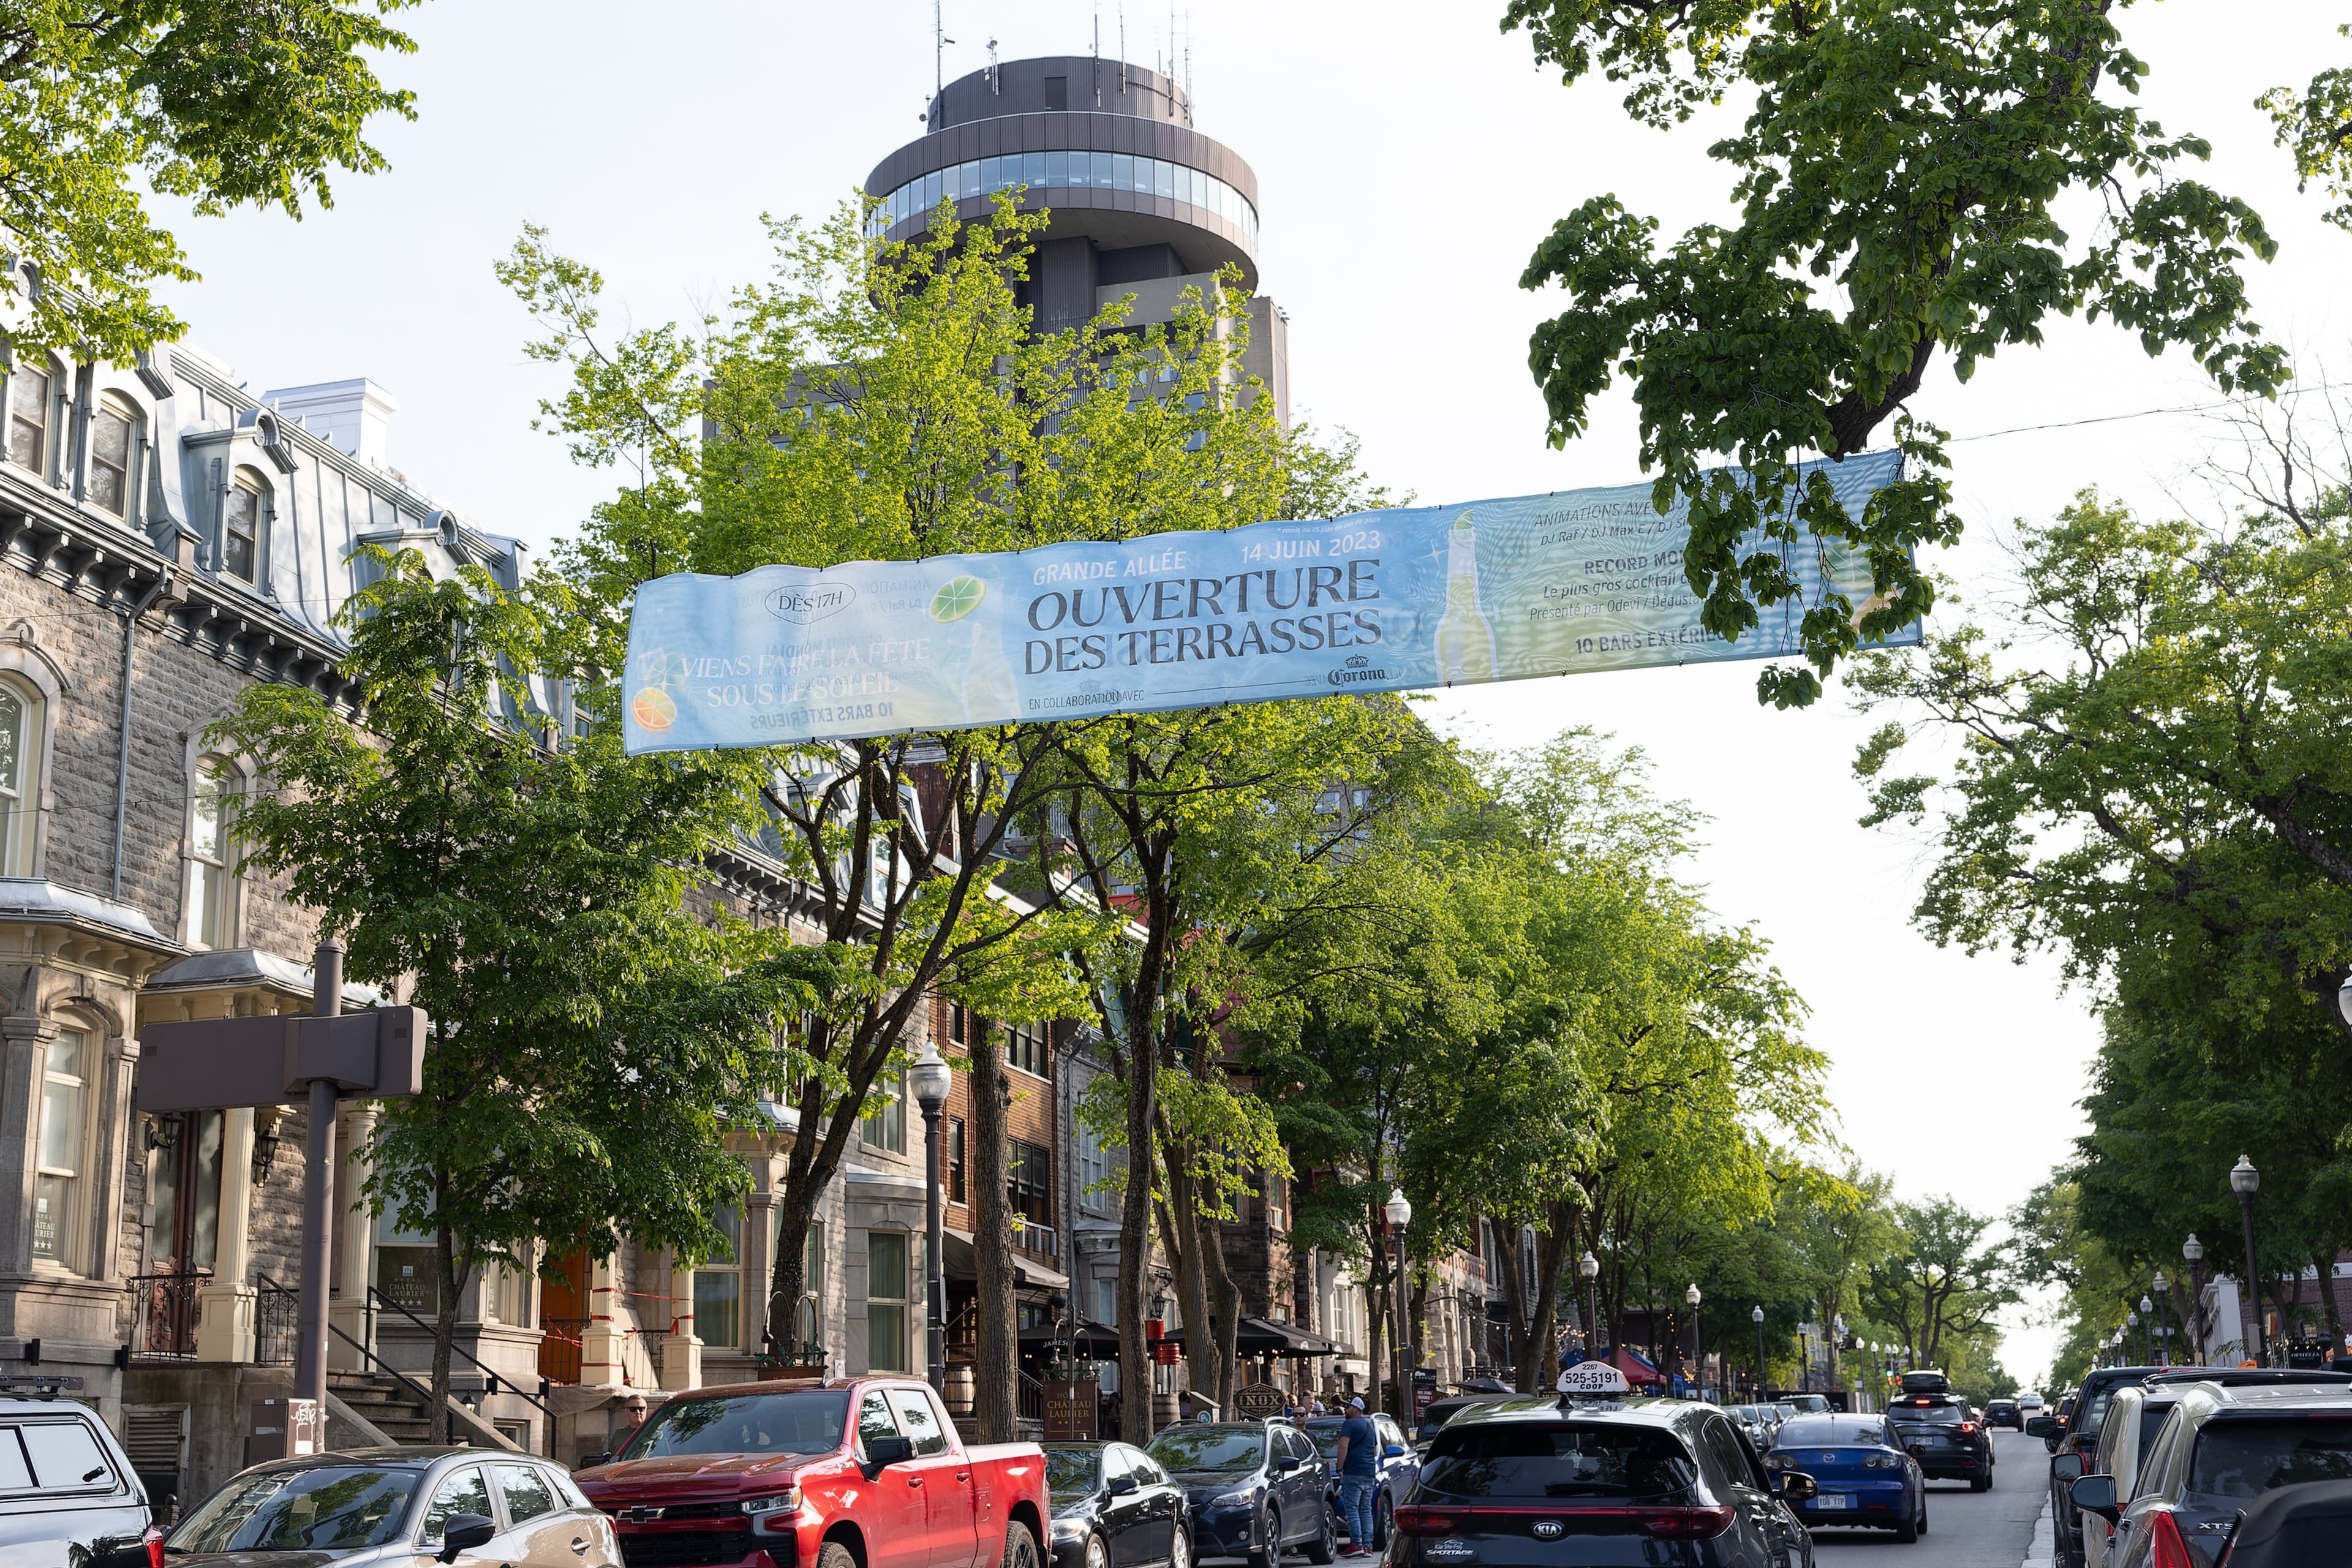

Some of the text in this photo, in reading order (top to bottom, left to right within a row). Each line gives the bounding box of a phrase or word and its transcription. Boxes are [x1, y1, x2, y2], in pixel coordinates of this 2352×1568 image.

[1534, 503, 1621, 528] ANIMATIONS
[1625, 501, 1657, 515] AVE
[1540, 533, 1555, 546] DJ
[1559, 529, 1579, 542] Raf
[1592, 526, 1606, 538] DJ
[1610, 526, 1634, 537] Max
[1638, 524, 1645, 533] E
[1658, 521, 1673, 532] DJ
[1242, 530, 1381, 564] 14 JUIN 2023
[1033, 549, 1187, 587] GRANDE ALLÉE
[1585, 556, 1648, 575] RECORD
[1027, 559, 1381, 631] OUVERTURE
[1543, 586, 1558, 598] Le
[1561, 583, 1588, 600] plus
[1593, 581, 1621, 597] gros
[1626, 571, 1676, 589] cocktail
[778, 594, 813, 613] DÈS
[816, 590, 843, 609] 17H
[1530, 602, 1581, 620] Présenté
[1584, 603, 1604, 617] par
[1607, 597, 1640, 612] Odevi
[1025, 608, 1383, 675] DES TERRASSES
[1575, 638, 1594, 654] 10
[1600, 631, 1643, 652] BARS
[681, 654, 752, 678] VIENS
[758, 649, 825, 677] FAIRE
[870, 636, 931, 664] FÊTE
[707, 683, 774, 707] SOUS
[781, 680, 808, 704] LE
[813, 671, 899, 699] SOLEIL
[1327, 668, 1387, 687] Corona
[1029, 689, 1145, 710] EN COLLABORATION AVEC
[388, 1281, 425, 1291] CHÂTEAU
[1566, 1372, 1618, 1384] 525-5191
[1239, 1395, 1280, 1406] INOX
[1537, 1525, 1558, 1534] KIA
